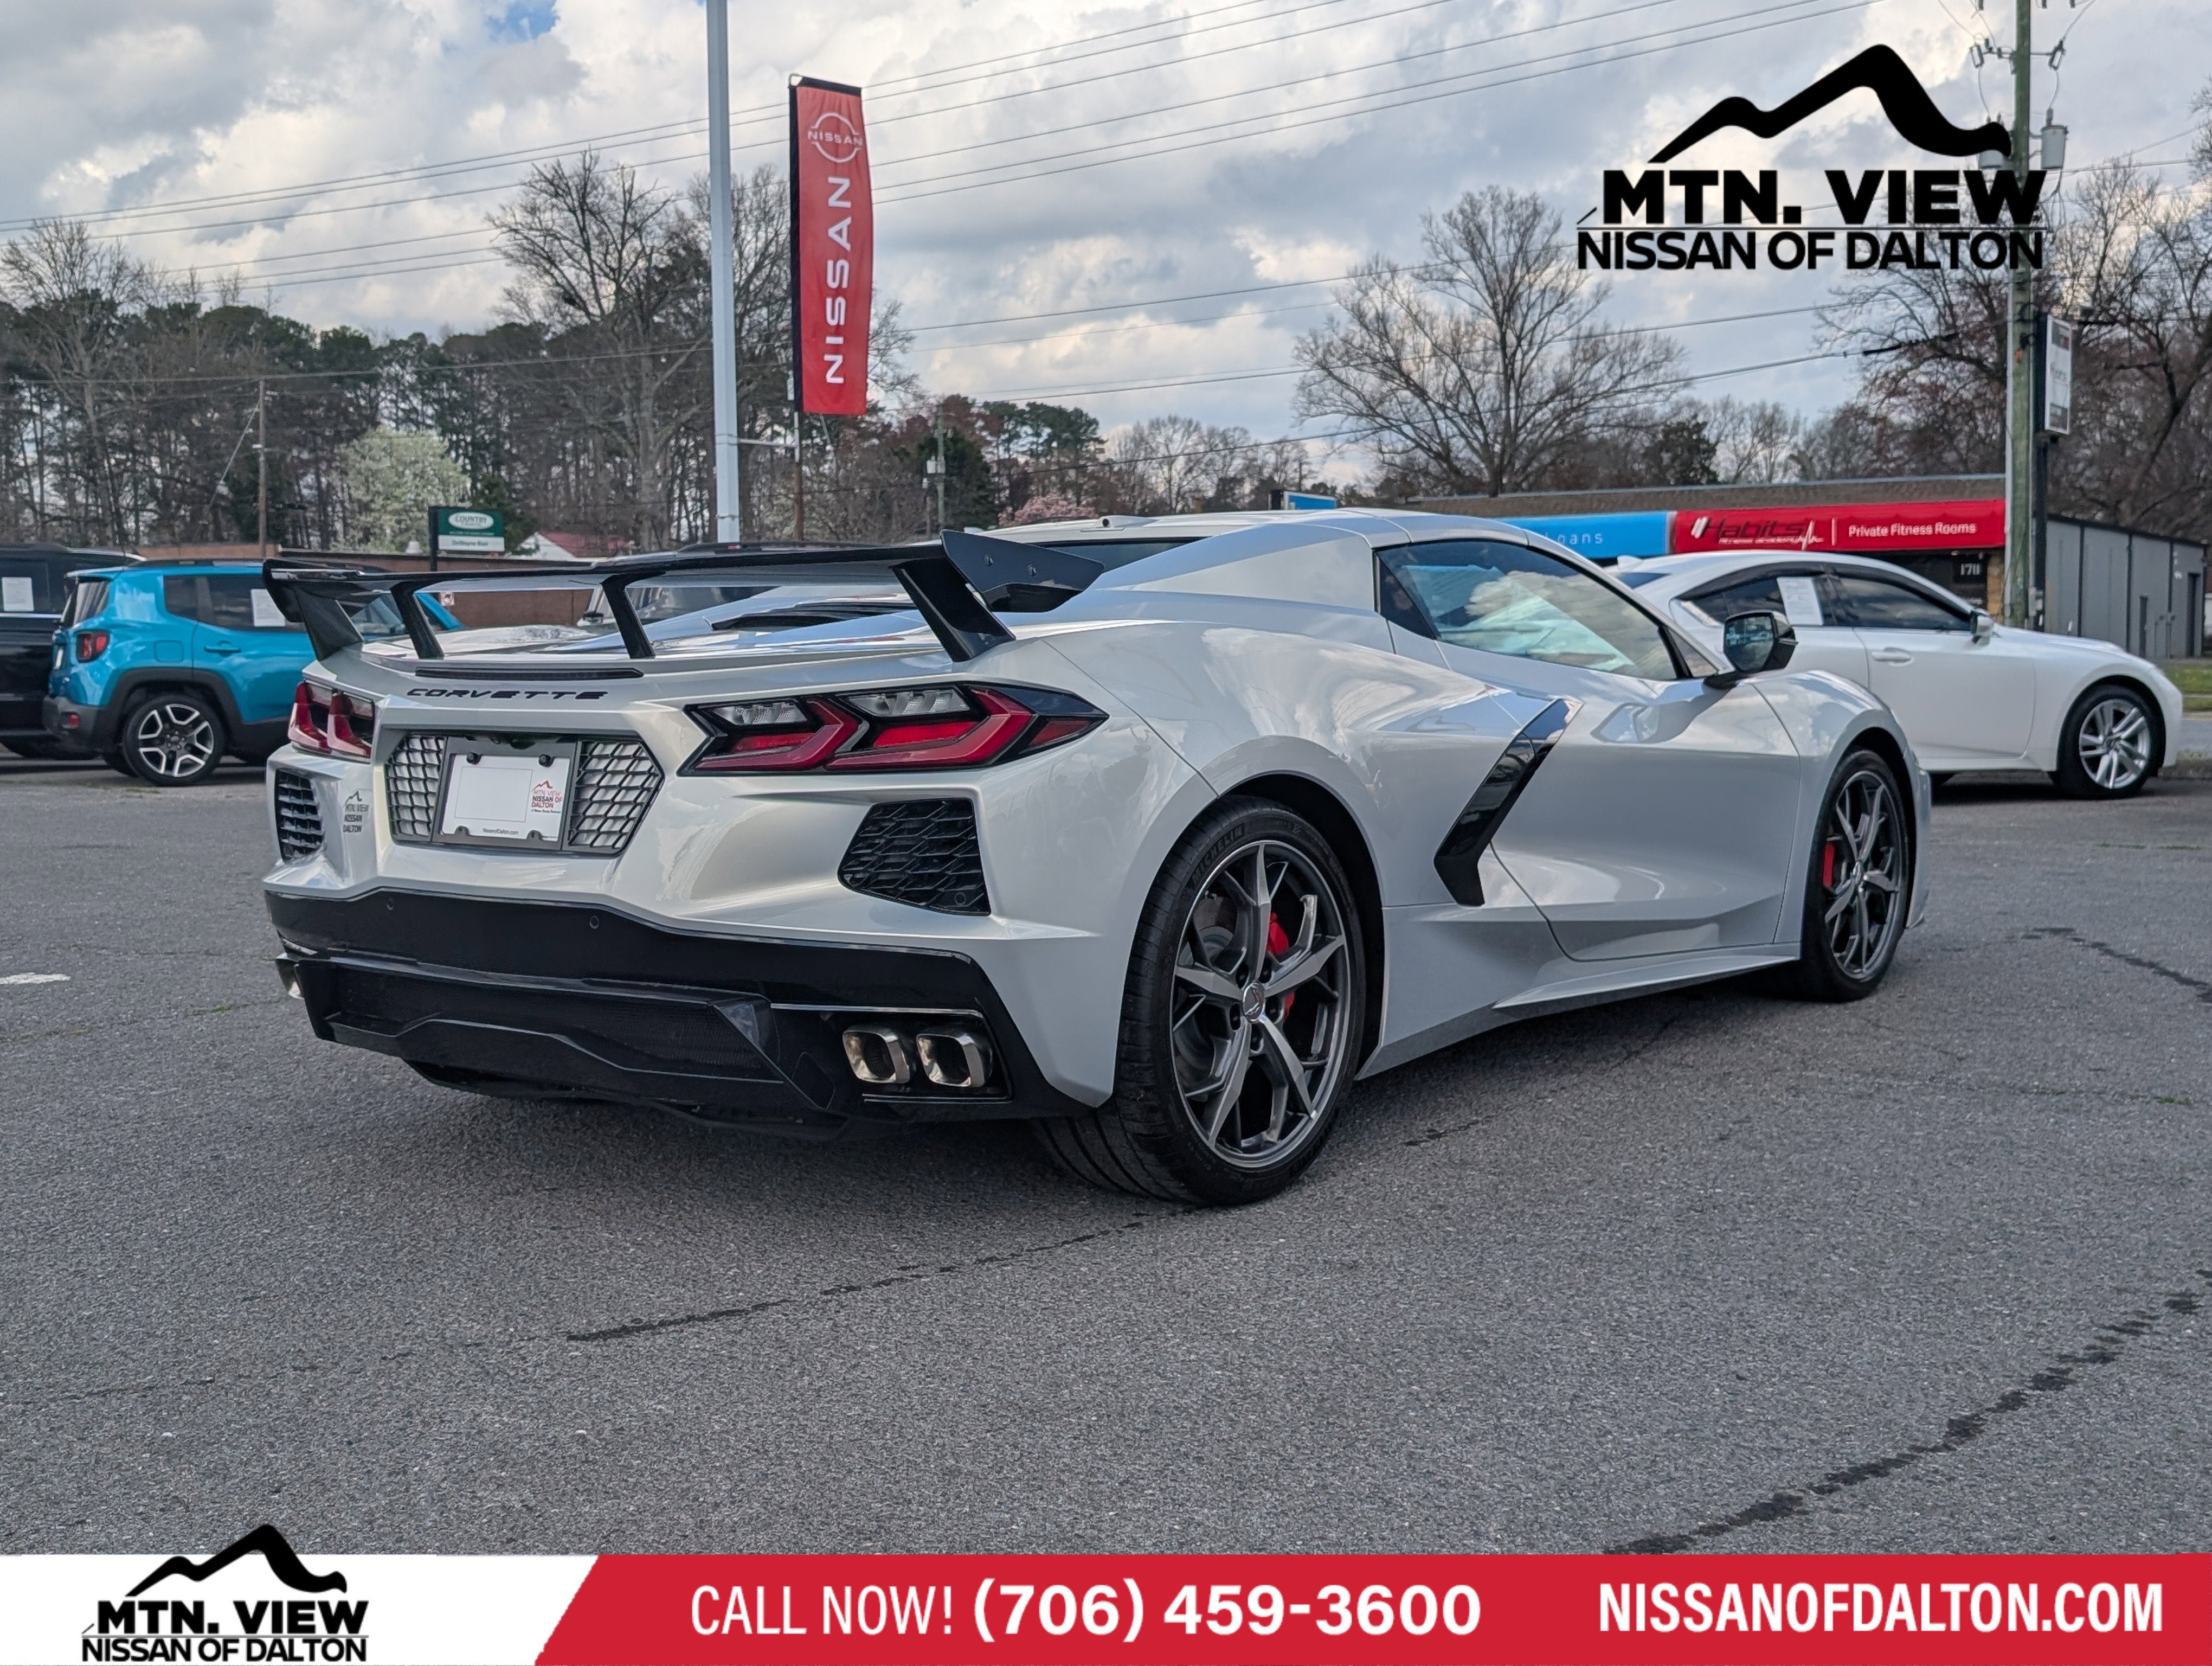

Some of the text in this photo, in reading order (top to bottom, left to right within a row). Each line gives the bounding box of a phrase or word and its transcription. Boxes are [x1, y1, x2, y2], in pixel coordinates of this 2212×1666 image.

[807, 130, 863, 146] NISSAN
[823, 175, 852, 384] NISSAN
[1848, 522, 1978, 537] Private Fitness Rooms
[407, 688, 608, 700] CORVETTE
[344, 814, 363, 822] NISSAN
[1191, 824, 1244, 886] MICHELIN
